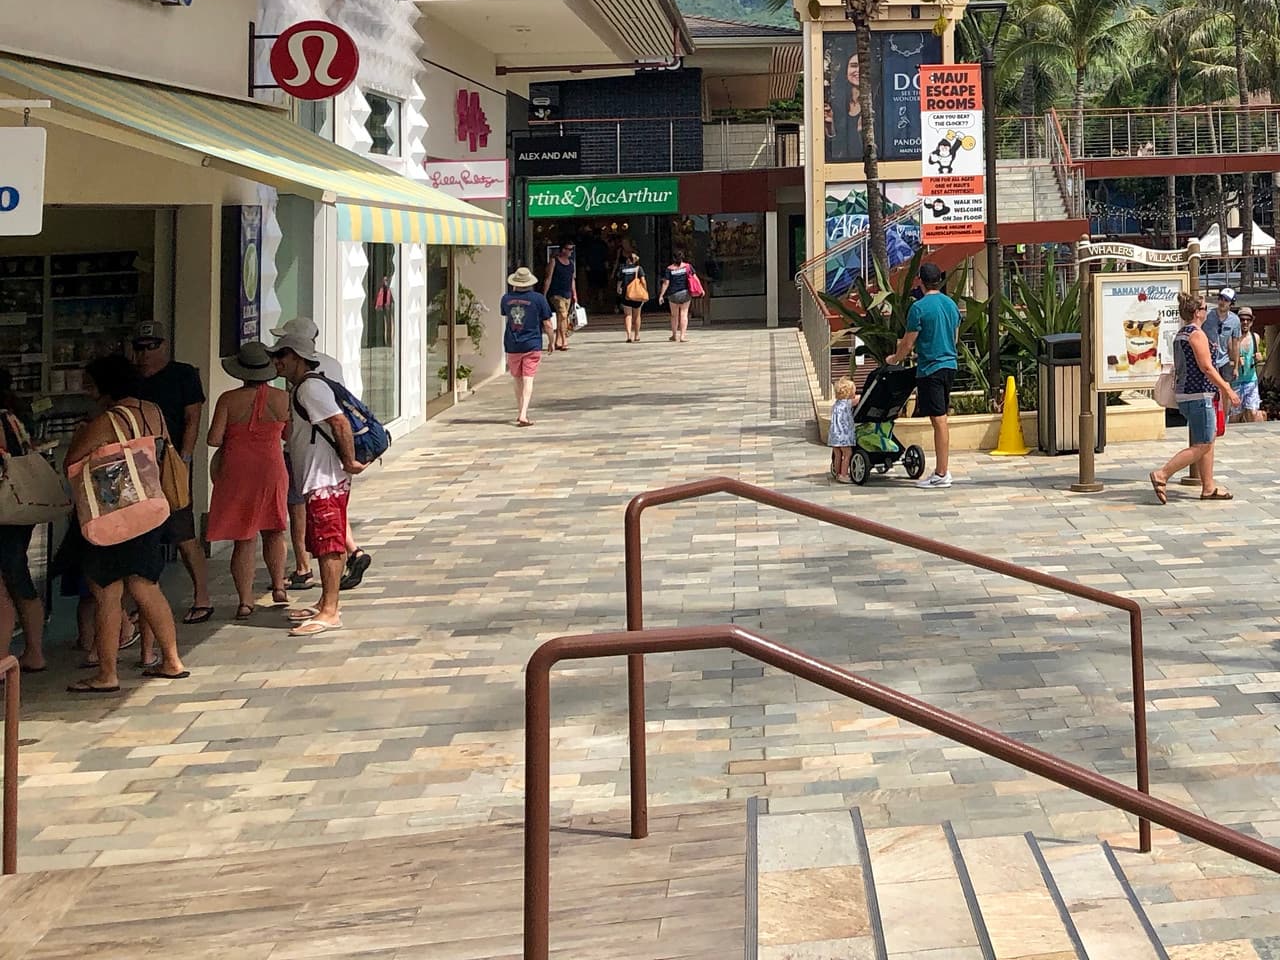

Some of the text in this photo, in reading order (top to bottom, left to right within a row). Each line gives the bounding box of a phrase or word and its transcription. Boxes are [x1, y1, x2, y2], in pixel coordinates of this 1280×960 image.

[932, 72, 969, 84] MAUI
[926, 85, 976, 97] ESCAPE
[926, 98, 976, 110] ROOMS
[894, 138, 921, 146] PANDO
[519, 151, 577, 161] ALEX AND ANI
[430, 170, 504, 190] Lilly Pulitzer
[826, 214, 870, 240] Aloh
[1088, 246, 1183, 263] WHALERS VILLAGE
[1112, 287, 1145, 296] BANANA
